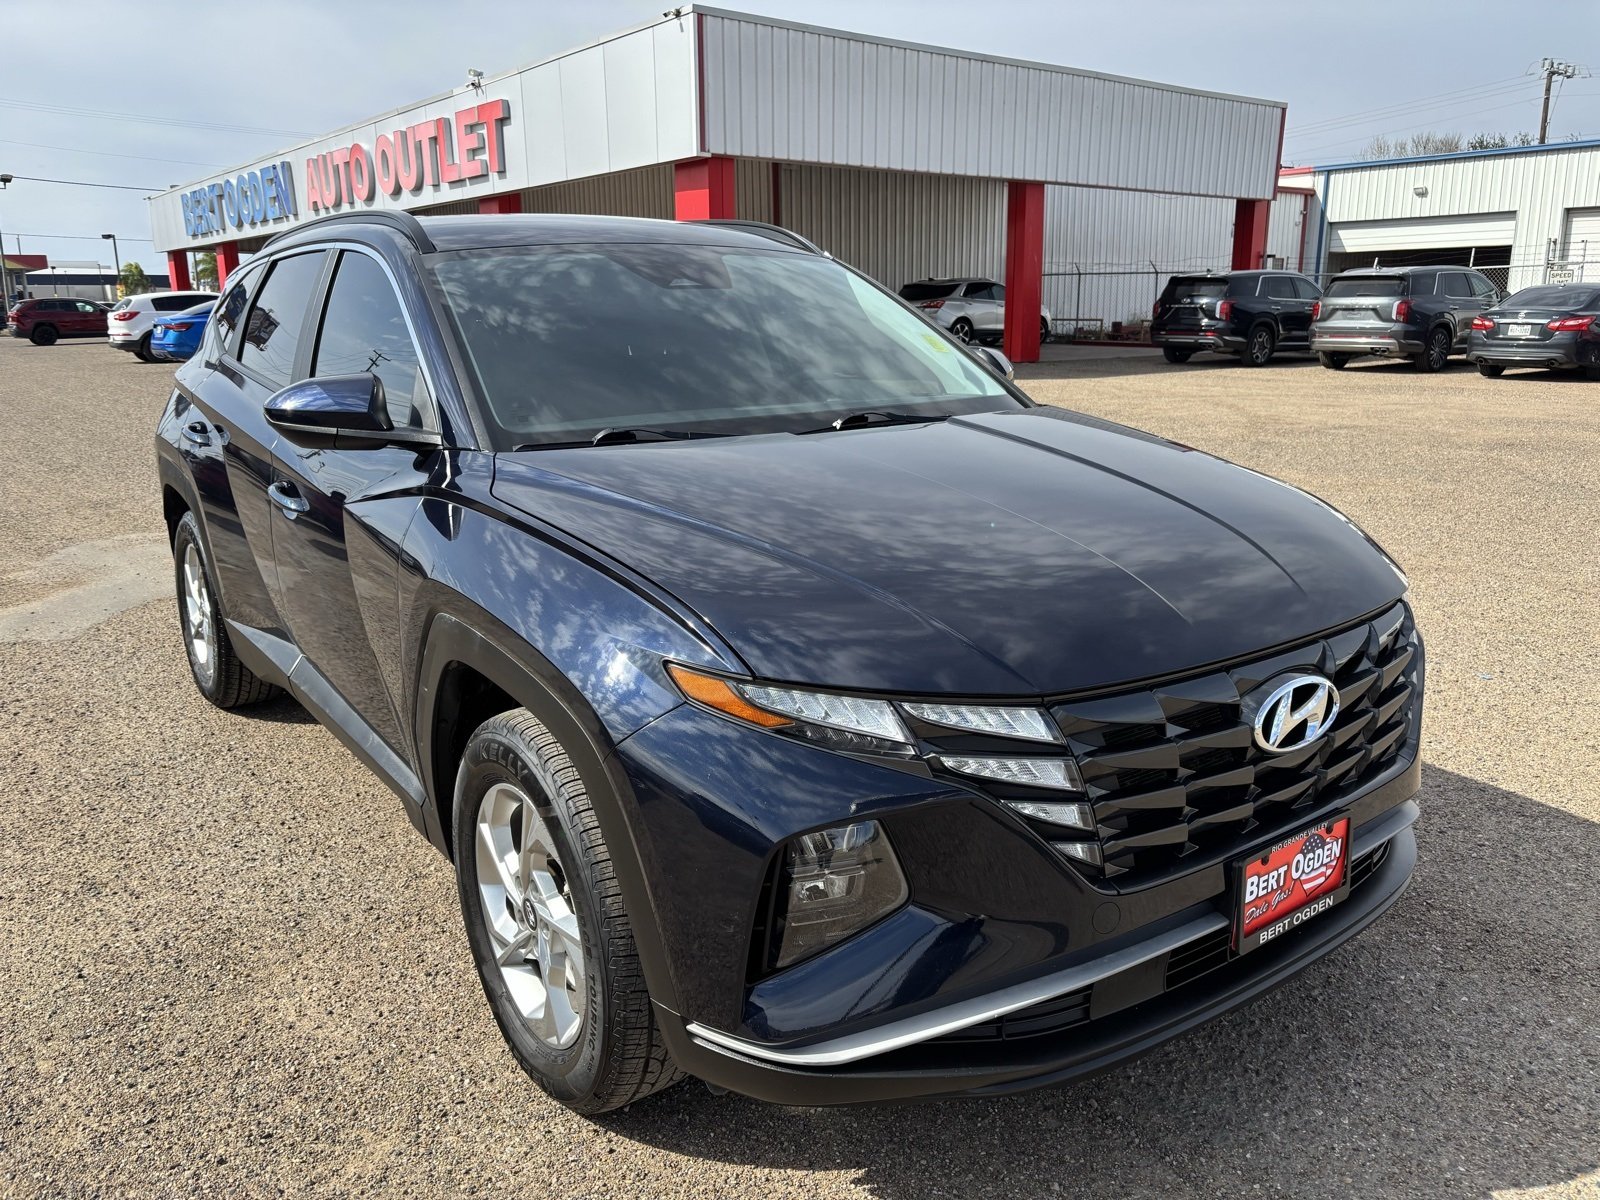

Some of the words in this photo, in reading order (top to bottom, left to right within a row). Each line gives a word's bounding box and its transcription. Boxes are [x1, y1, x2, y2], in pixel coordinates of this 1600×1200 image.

[181, 183, 224, 236] BERT
[224, 161, 295, 228] OGDEN
[306, 143, 373, 211] AUTO
[375, 99, 508, 195] OUTLET
[480, 742, 529, 780] KELLY
[1271, 843, 1283, 854] RIO
[1283, 832, 1308, 848] GRANDE
[1307, 821, 1329, 837] VALLEY
[1245, 865, 1288, 904] BERT
[1291, 838, 1342, 880] OGDEN
[1259, 918, 1291, 944] BERT
[1293, 895, 1334, 925] OGDEN
[588, 973, 598, 1051] TOURING
